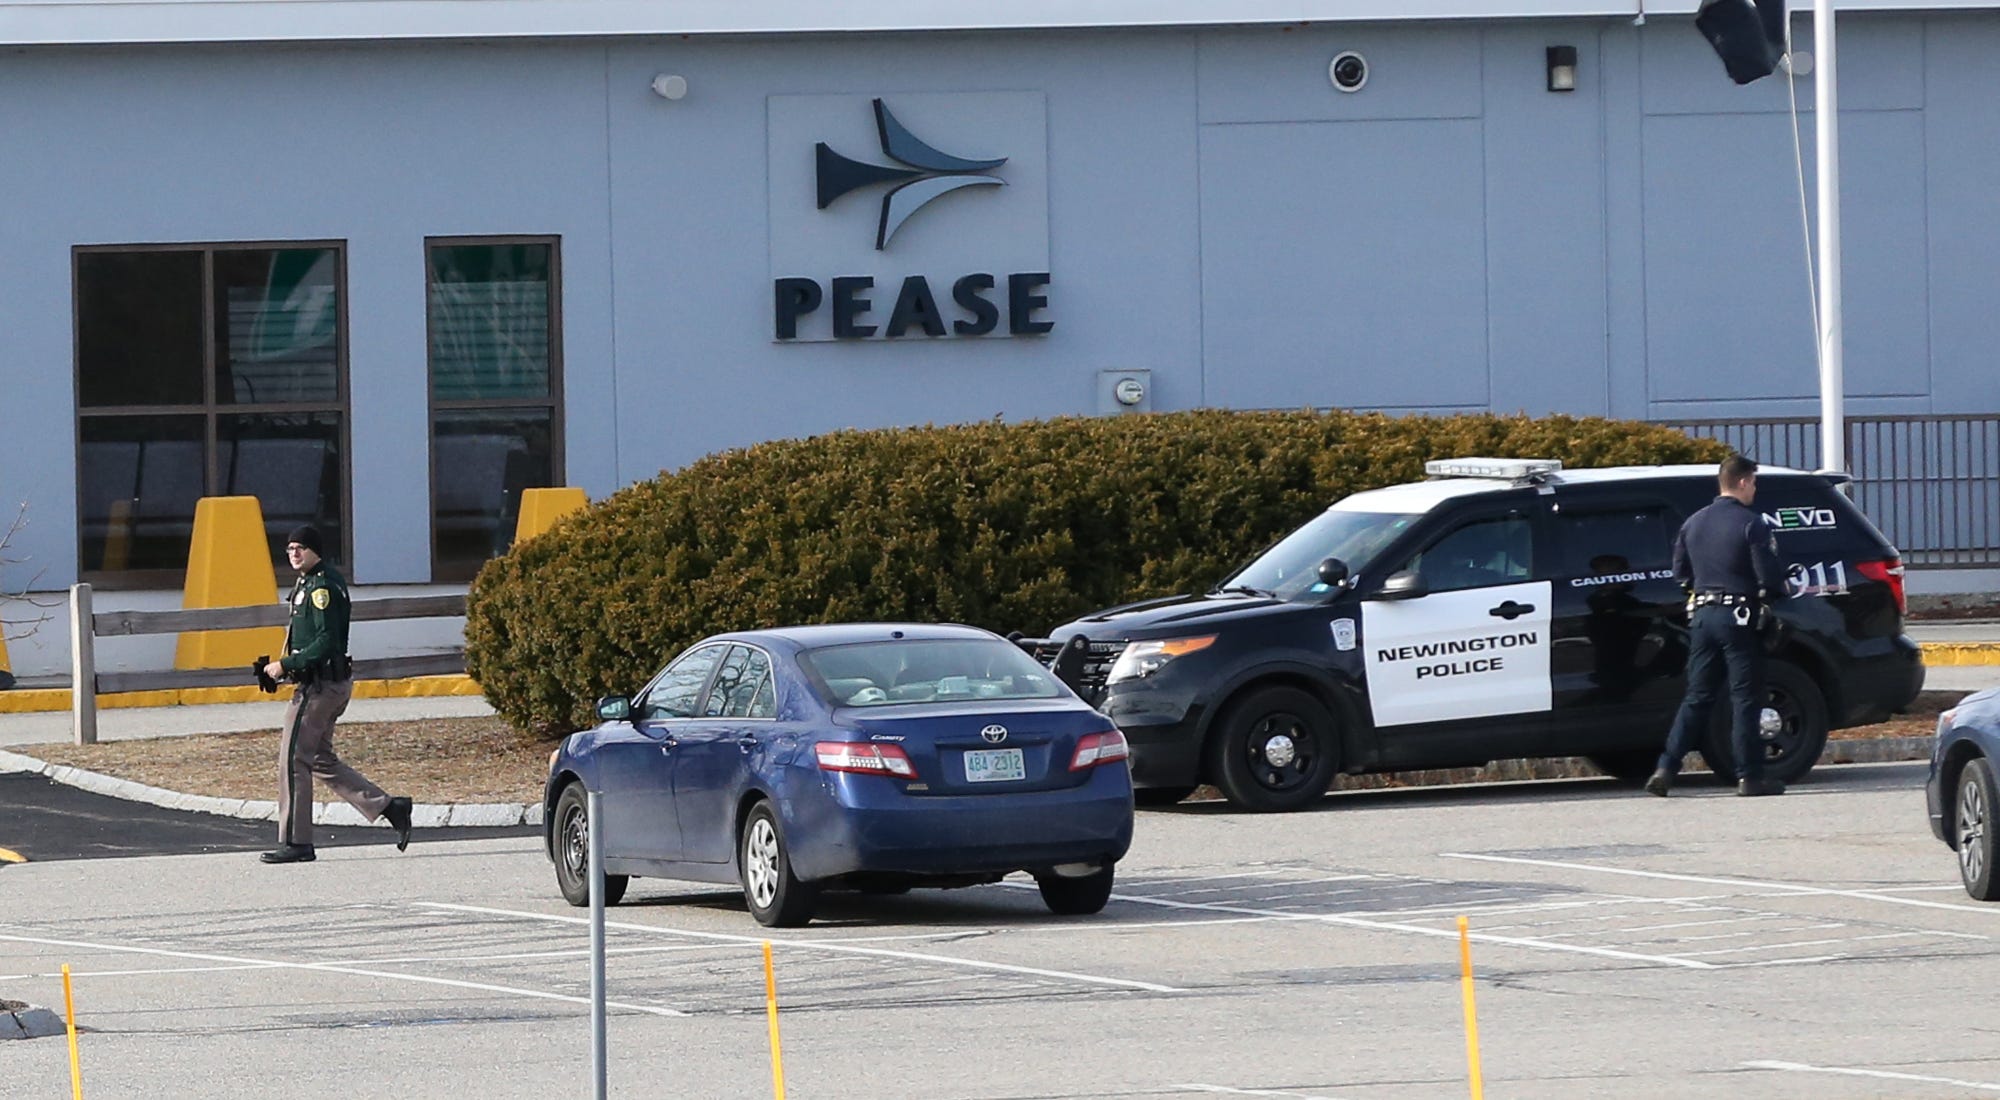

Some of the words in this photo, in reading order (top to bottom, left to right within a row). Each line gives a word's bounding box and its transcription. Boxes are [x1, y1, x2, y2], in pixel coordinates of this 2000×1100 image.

[774, 273, 1055, 339] PEASE
[1571, 572, 1646, 587] CAUTION
[1786, 560, 1851, 599] 911
[1378, 632, 1538, 662] NEWINGTON
[1416, 657, 1504, 679] POLICE
